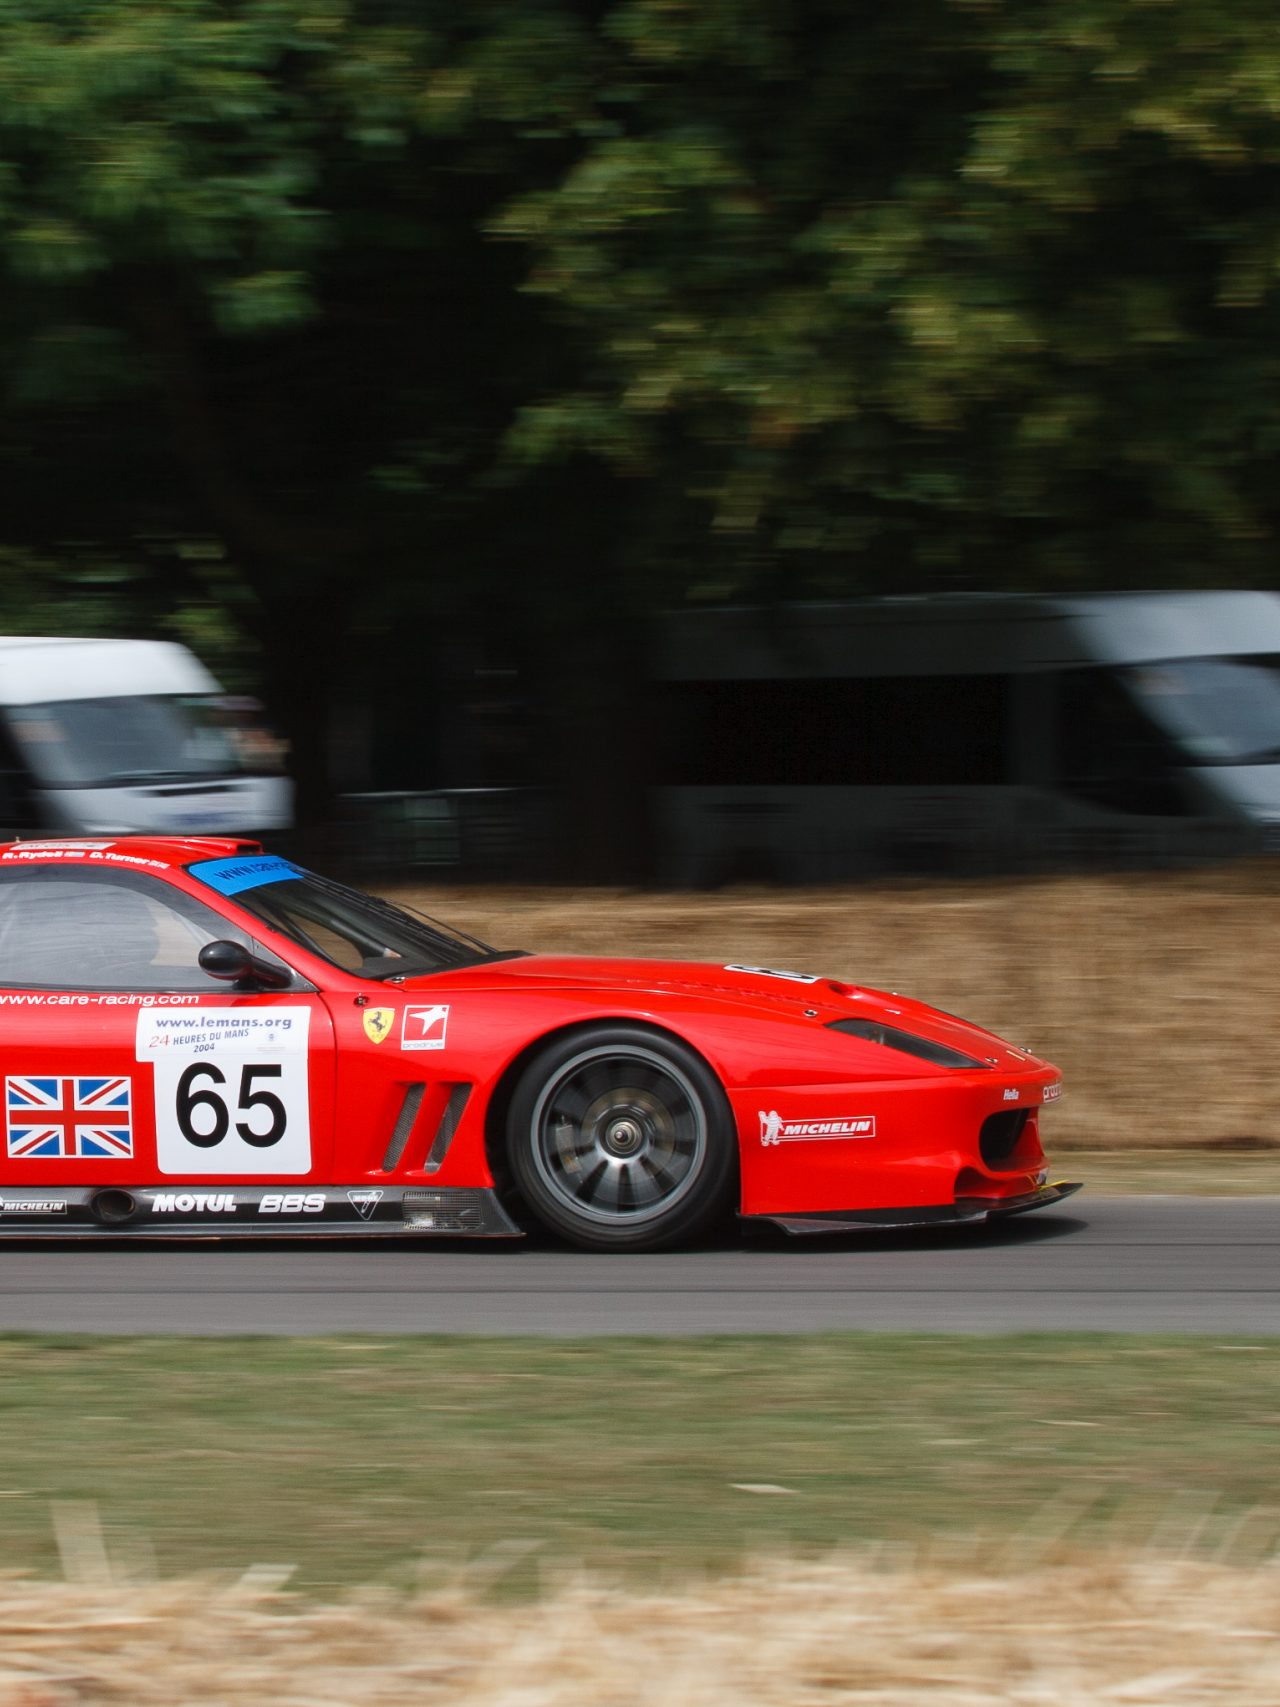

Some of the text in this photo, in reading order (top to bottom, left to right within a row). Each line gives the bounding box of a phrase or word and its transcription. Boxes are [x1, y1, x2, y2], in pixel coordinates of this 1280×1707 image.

[156, 1016, 292, 1029] www.lemans.org
[149, 1028, 250, 1048] 24 HEURES DU MANS
[193, 1043, 215, 1053] 2004
[176, 1062, 287, 1148] 65
[784, 1121, 871, 1136] MICHELIN
[2, 1202, 64, 1211] MICHELIN
[152, 1194, 237, 1213] MOTUL
[258, 1194, 326, 1213] BBS
